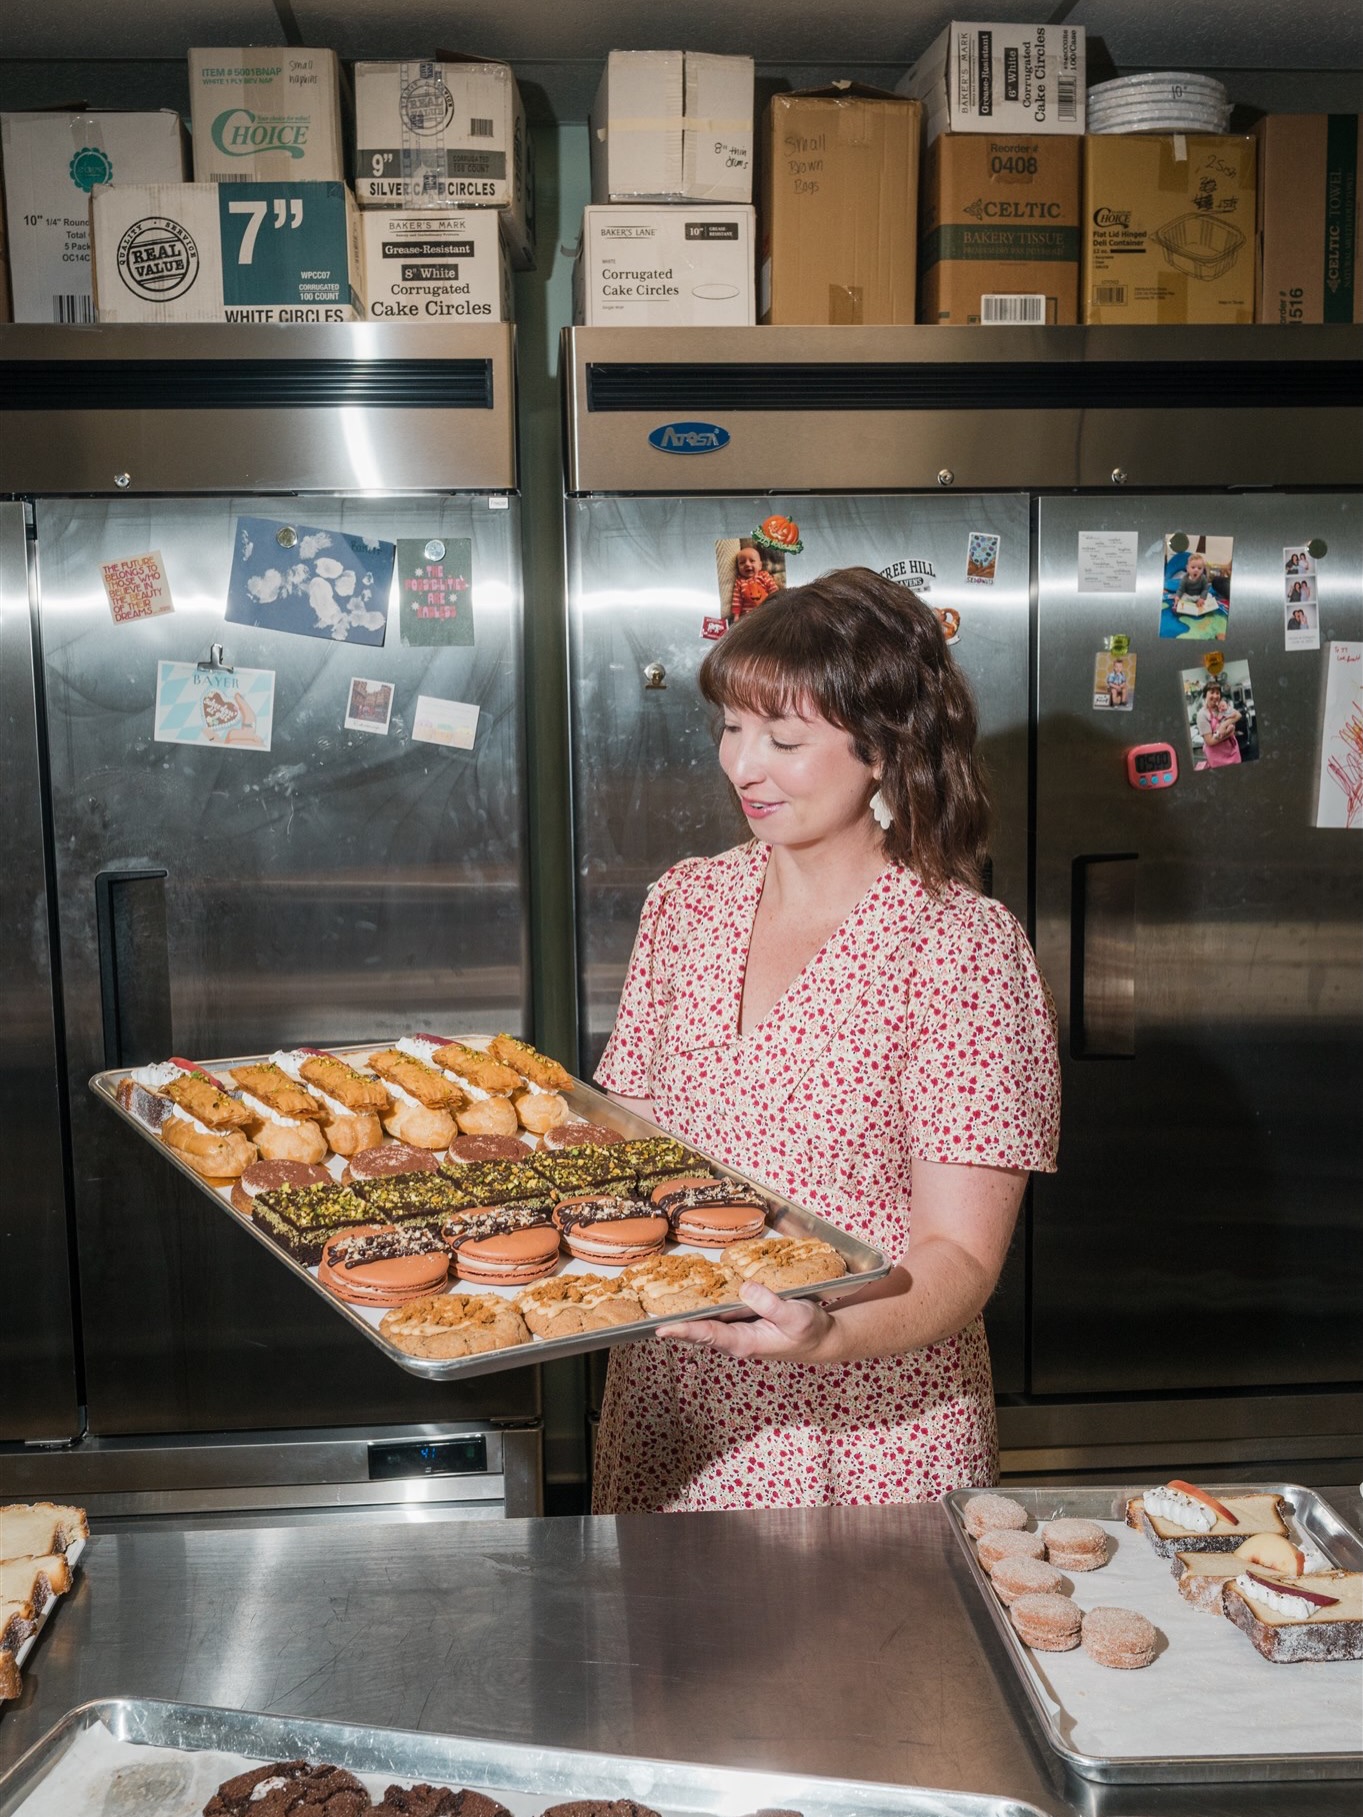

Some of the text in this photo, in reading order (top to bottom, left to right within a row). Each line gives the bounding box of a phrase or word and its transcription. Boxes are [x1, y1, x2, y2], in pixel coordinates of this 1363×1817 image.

[202, 68, 226, 77] ITEM
[289, 60, 313, 72] Small
[961, 32, 969, 114] BAKER'S MARK
[1008, 50, 1017, 83] White
[981, 34, 989, 114] Grease-Resistant
[1022, 41, 1034, 108] Corrugated
[1034, 27, 1046, 122] Cake Circles
[211, 108, 309, 159] CHOICE
[729, 146, 747, 156] thin
[784, 133, 826, 157] Small
[991, 143, 1029, 153] Reorder
[991, 156, 1038, 174] 0408
[369, 182, 409, 196] SILVER
[414, 182, 446, 196] CAD
[447, 182, 496, 196] CIRCLES
[983, 202, 1061, 218] CELTIC
[389, 220, 466, 230] BAKER'S MARK
[1093, 207, 1131, 229] CHOICE
[1329, 168, 1342, 279] CELTIC TOWEL
[66, 231, 86, 239] Total
[601, 228, 656, 237] BAKER'S LANE
[963, 231, 1064, 244] BAKERY TISSUE
[1121, 231, 1147, 239] Hinged
[119, 222, 197, 265] QUALITY SERVICE
[385, 244, 471, 255] Grease-Resistant
[131, 244, 182, 265] REAL
[135, 259, 185, 277] VALUE
[301, 271, 331, 279] WPCC07
[420, 268, 456, 279] White
[602, 268, 673, 282] Corrugated
[299, 283, 340, 291] CORRUGATED
[391, 283, 471, 297] Corrugated
[602, 284, 680, 296] Cake Circles
[300, 292, 340, 301] 100 COUNT
[371, 300, 492, 316] Cake Circles
[102, 556, 155, 574] THE FUTURE
[909, 560, 936, 578] HILL
[104, 564, 158, 582] BELONGS TO
[108, 572, 161, 589] THOSE WHO
[109, 582, 153, 598] BELIEVE IN
[112, 588, 162, 605] THE BEAUTY
[113, 605, 124, 614] OF
[128, 600, 151, 610] THEIR
[115, 607, 152, 621] DREAMS
[193, 674, 239, 689] BAYER
